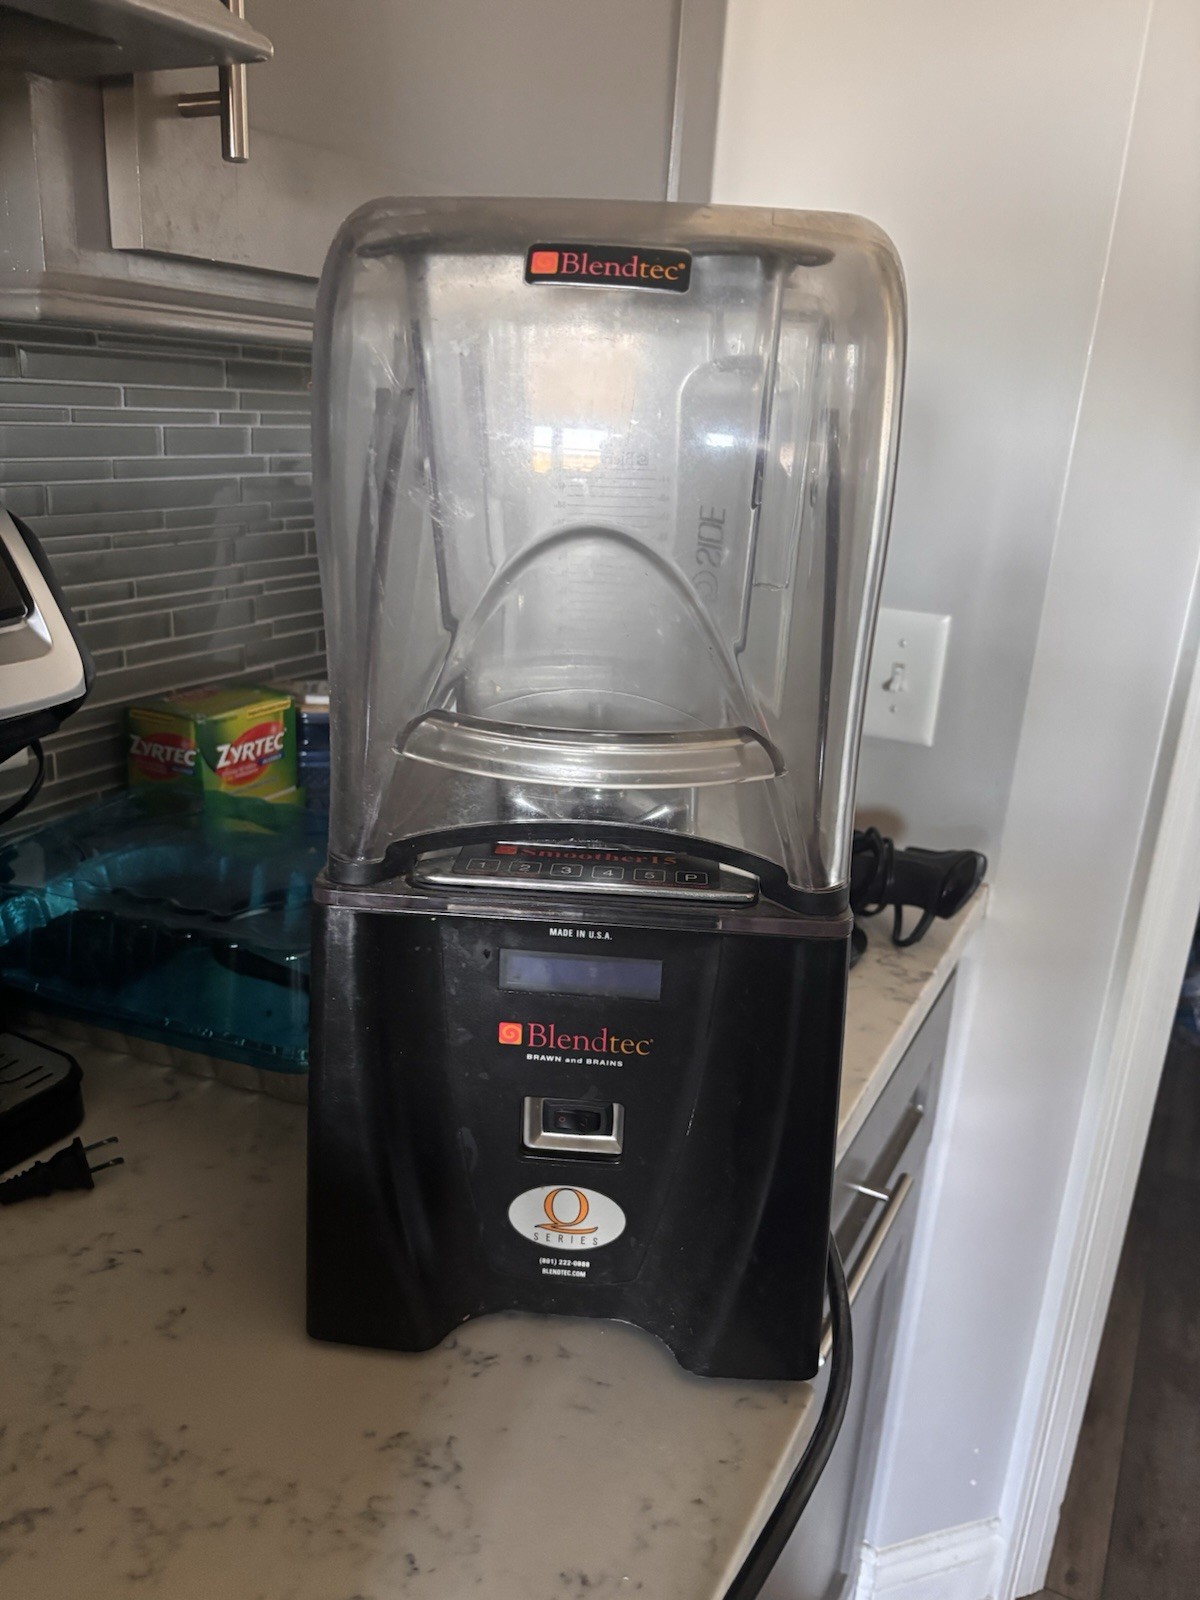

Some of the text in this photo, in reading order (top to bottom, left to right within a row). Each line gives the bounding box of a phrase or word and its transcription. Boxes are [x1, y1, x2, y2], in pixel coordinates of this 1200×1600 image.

[560, 252, 679, 281] Blendtec
[128, 734, 197, 767] ZYRTEC
[215, 732, 284, 769] ZYRTEC
[520, 863, 531, 873] 2
[560, 866, 572, 875] 3
[602, 869, 614, 877] 4
[644, 871, 656, 880] 5
[684, 874, 698, 882] P
[549, 927, 613, 941] MADE IN U.S.A.
[527, 1022, 651, 1056] Blendtec
[526, 1053, 624, 1067] BRAWN and BRAINS
[534, 1187, 599, 1235] Q
[533, 1232, 599, 1246] SERIES
[542, 1268, 586, 1278] BLENDTEC.COM
